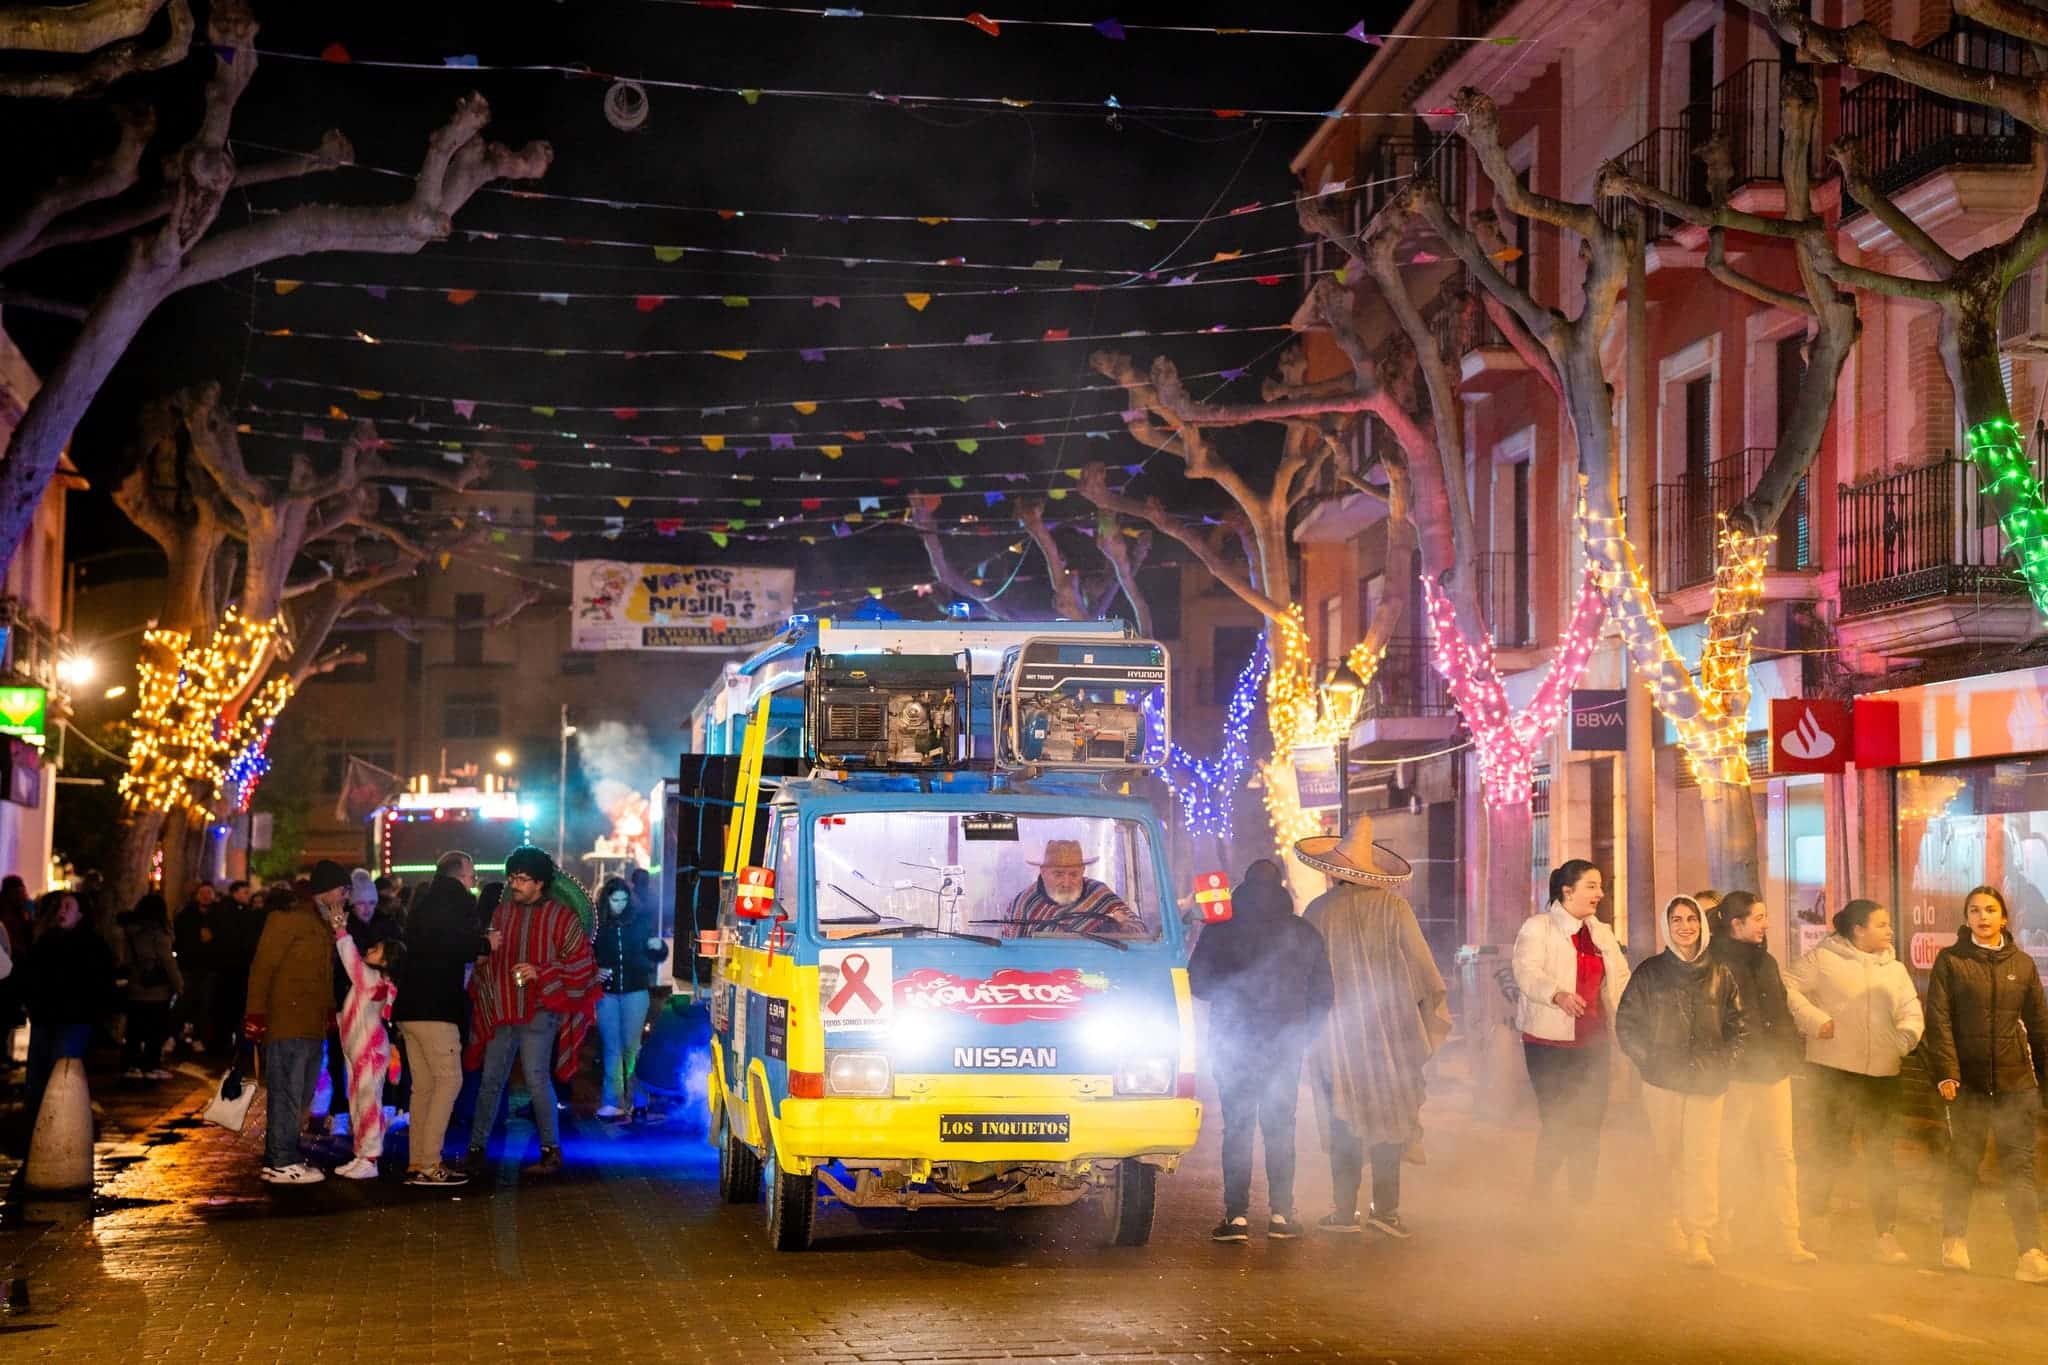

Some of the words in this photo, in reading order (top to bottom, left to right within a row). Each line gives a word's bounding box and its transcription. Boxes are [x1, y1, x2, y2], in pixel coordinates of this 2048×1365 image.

[725, 585, 753, 601] ls
[1127, 670, 1163, 679] HYUNDAI
[1576, 712, 1624, 728] BBVA
[1913, 905, 1921, 925] a
[1923, 897, 1936, 925] la
[953, 1047, 1057, 1068] NISSAN
[942, 1121, 974, 1135] LOS
[982, 1121, 1068, 1135] INQUIETOS
